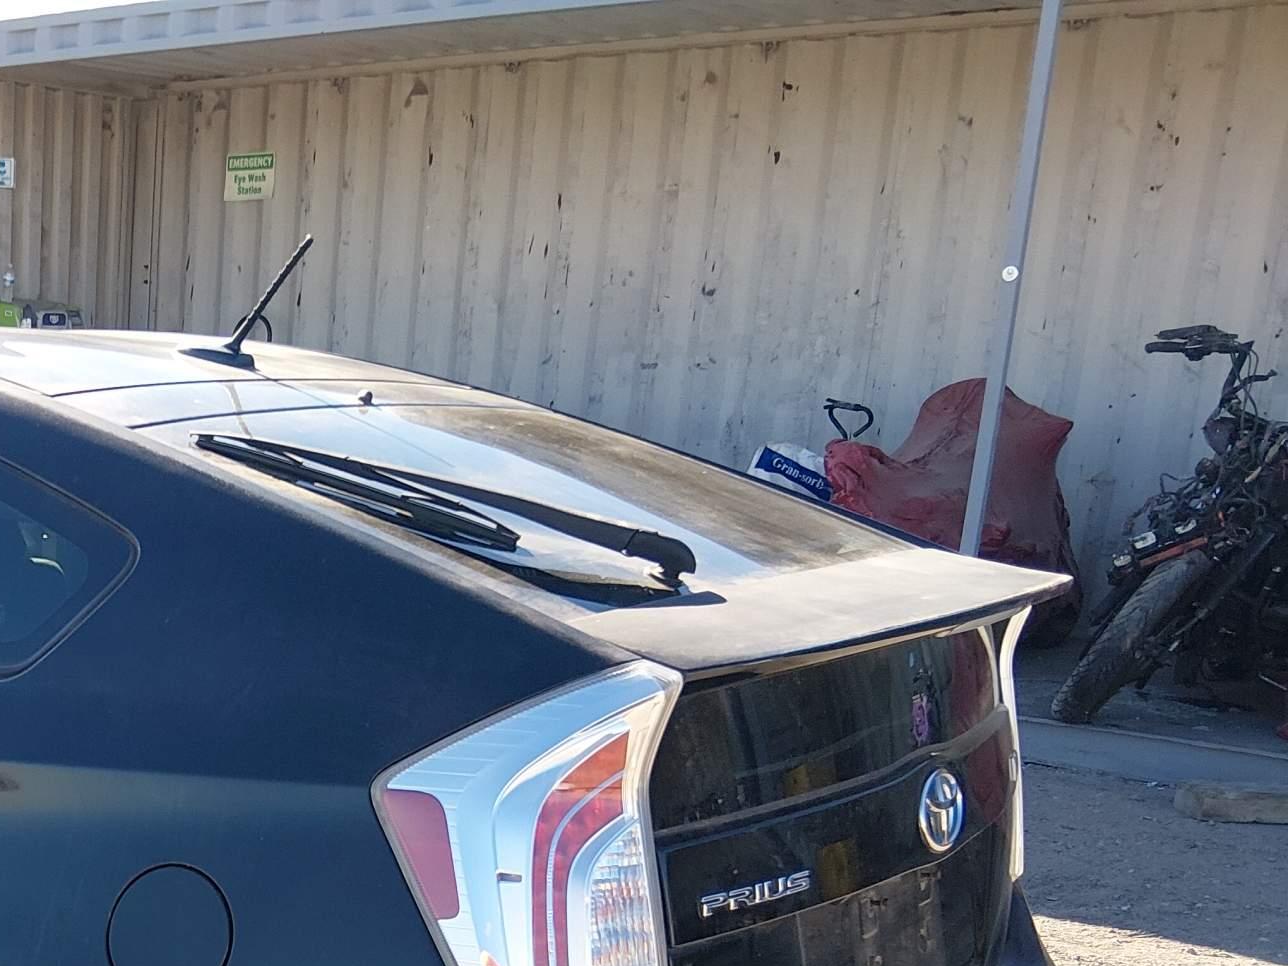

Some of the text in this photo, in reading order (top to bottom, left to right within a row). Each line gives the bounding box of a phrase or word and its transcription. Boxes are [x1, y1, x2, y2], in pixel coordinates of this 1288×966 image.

[228, 156, 273, 169] EMERGENCY
[233, 172, 266, 186] Eye Wash
[237, 186, 262, 195] Station
[700, 870, 811, 917] PRIUS
